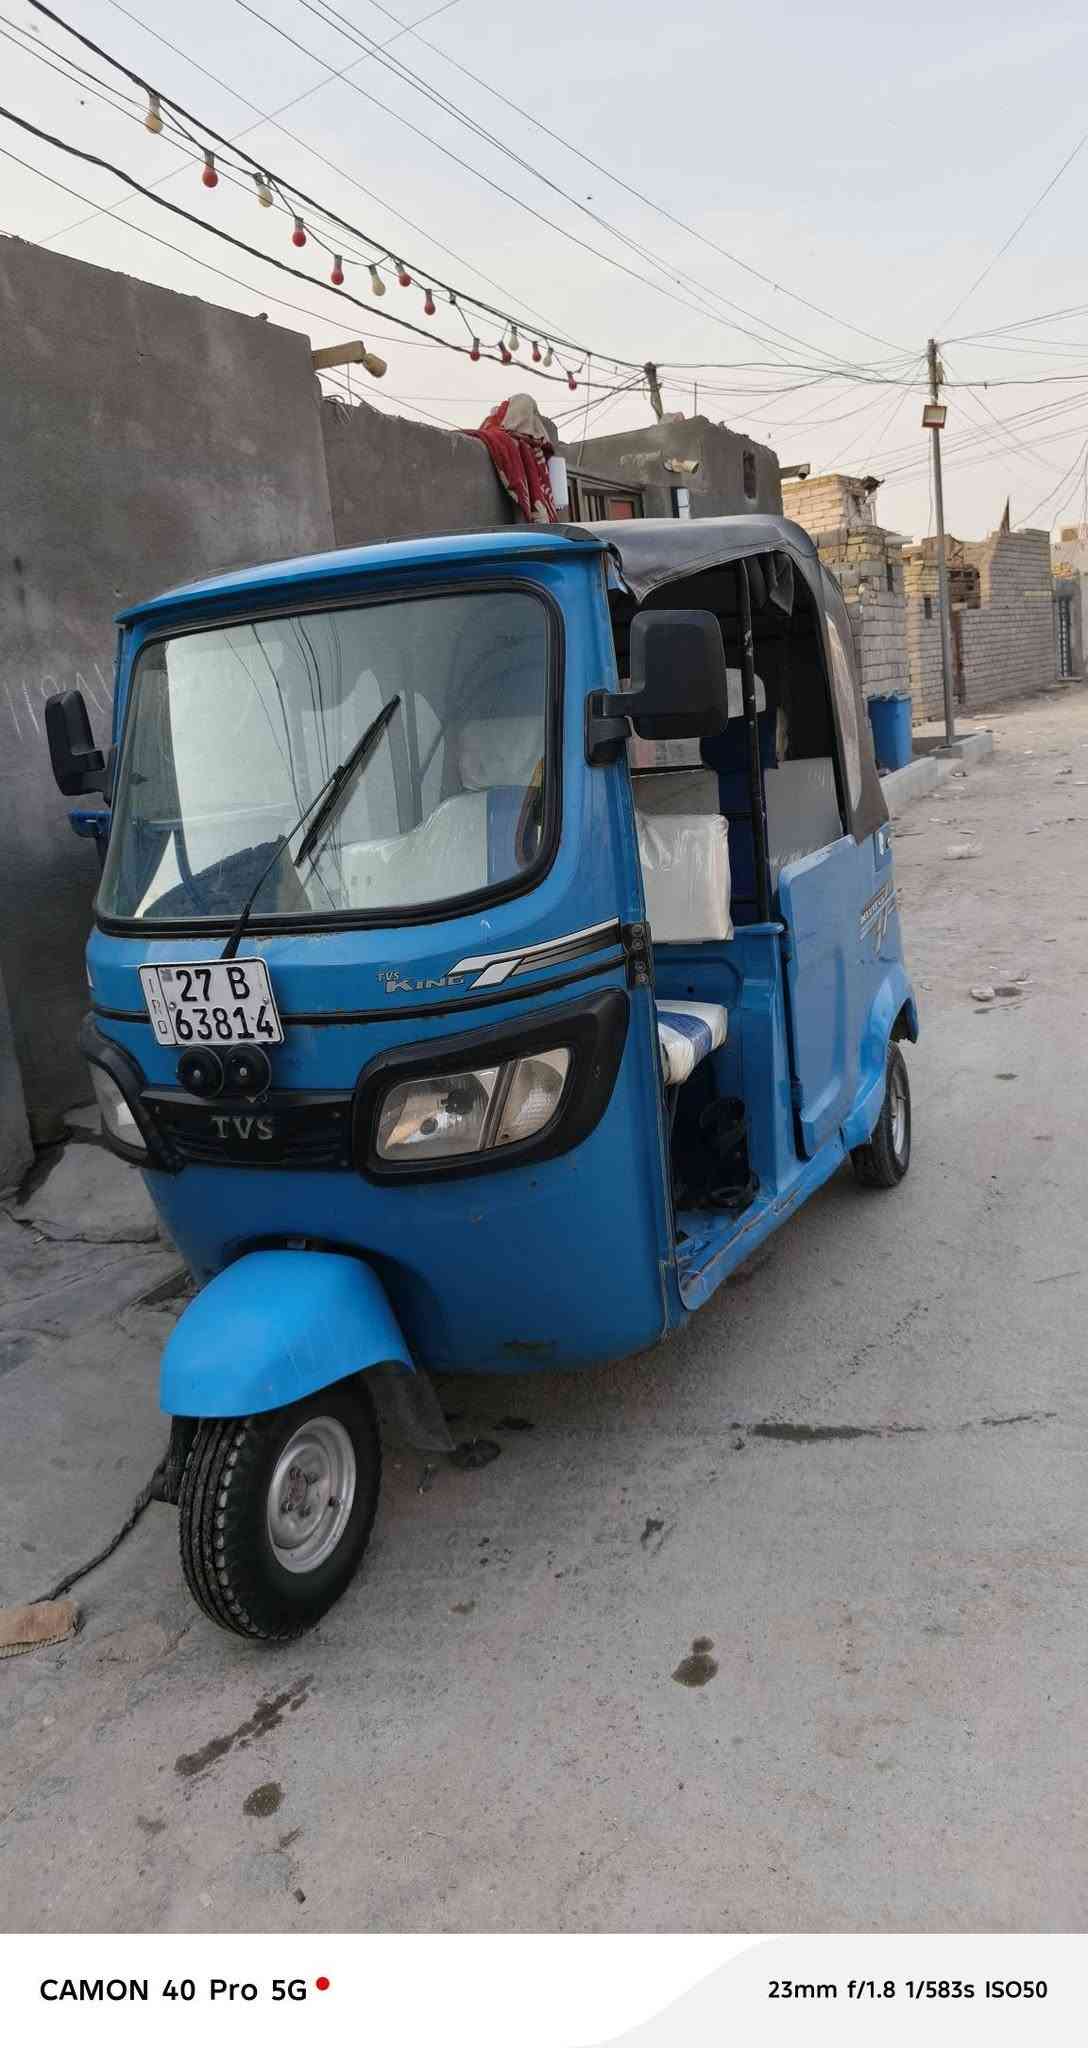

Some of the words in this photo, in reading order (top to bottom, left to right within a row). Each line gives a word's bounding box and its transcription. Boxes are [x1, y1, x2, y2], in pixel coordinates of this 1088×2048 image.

[175, 968, 212, 1002] 27
[226, 966, 250, 1000] B
[175, 1005, 274, 1040] 63814
[210, 1115, 273, 1140] TVS
